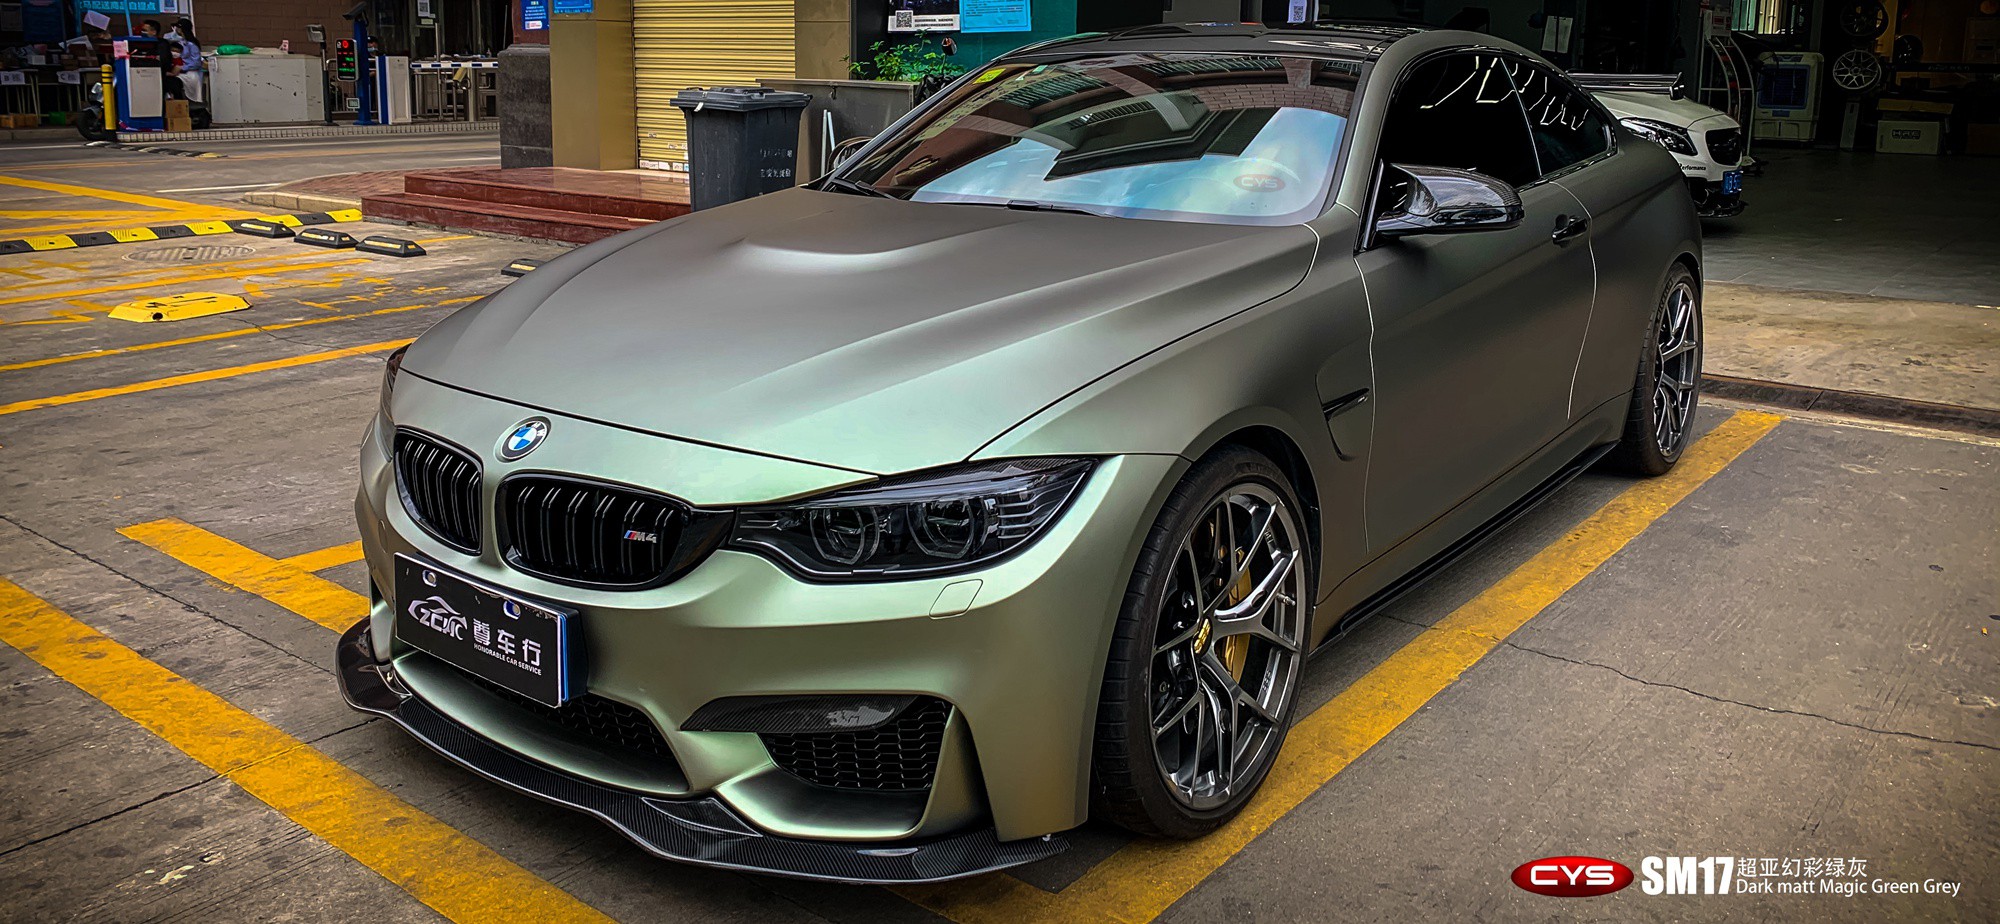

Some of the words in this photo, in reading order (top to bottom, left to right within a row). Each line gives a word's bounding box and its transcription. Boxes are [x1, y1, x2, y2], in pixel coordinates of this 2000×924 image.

[629, 530, 657, 543] M4
[473, 618, 541, 666] 尊车行
[474, 643, 506, 661] HONORABLE
[506, 656, 518, 667] CAR
[518, 661, 542, 676] SERVICE
